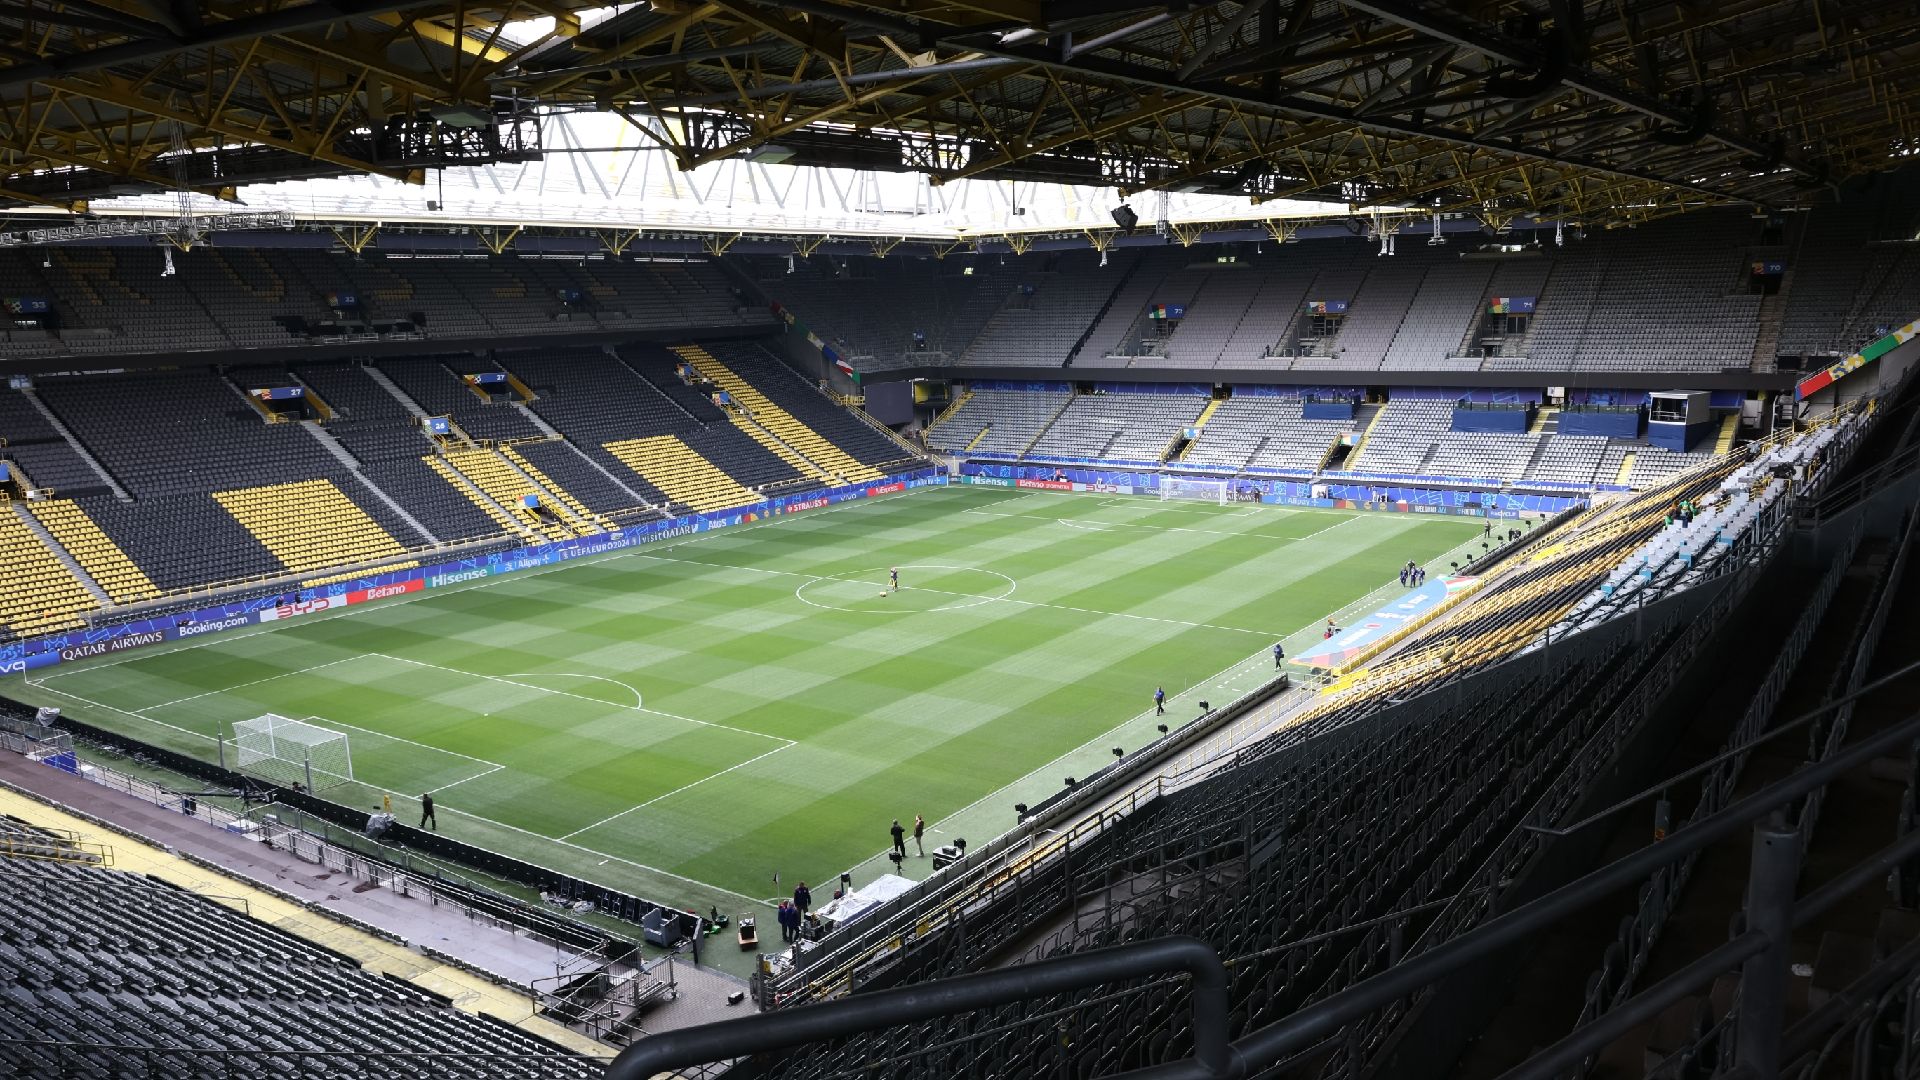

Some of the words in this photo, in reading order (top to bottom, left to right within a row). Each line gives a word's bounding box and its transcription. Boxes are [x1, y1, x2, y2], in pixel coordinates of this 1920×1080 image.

[290, 388, 302, 396] 27
[970, 476, 1008, 486] Hisense
[793, 499, 822, 512] STRAUSS
[432, 568, 488, 588] Hisense
[367, 584, 405, 600] Betano
[276, 598, 330, 619] BYD
[179, 617, 248, 637] Booking.com
[62, 644, 106, 661] QATAR
[111, 632, 163, 650] AIRWAYS
